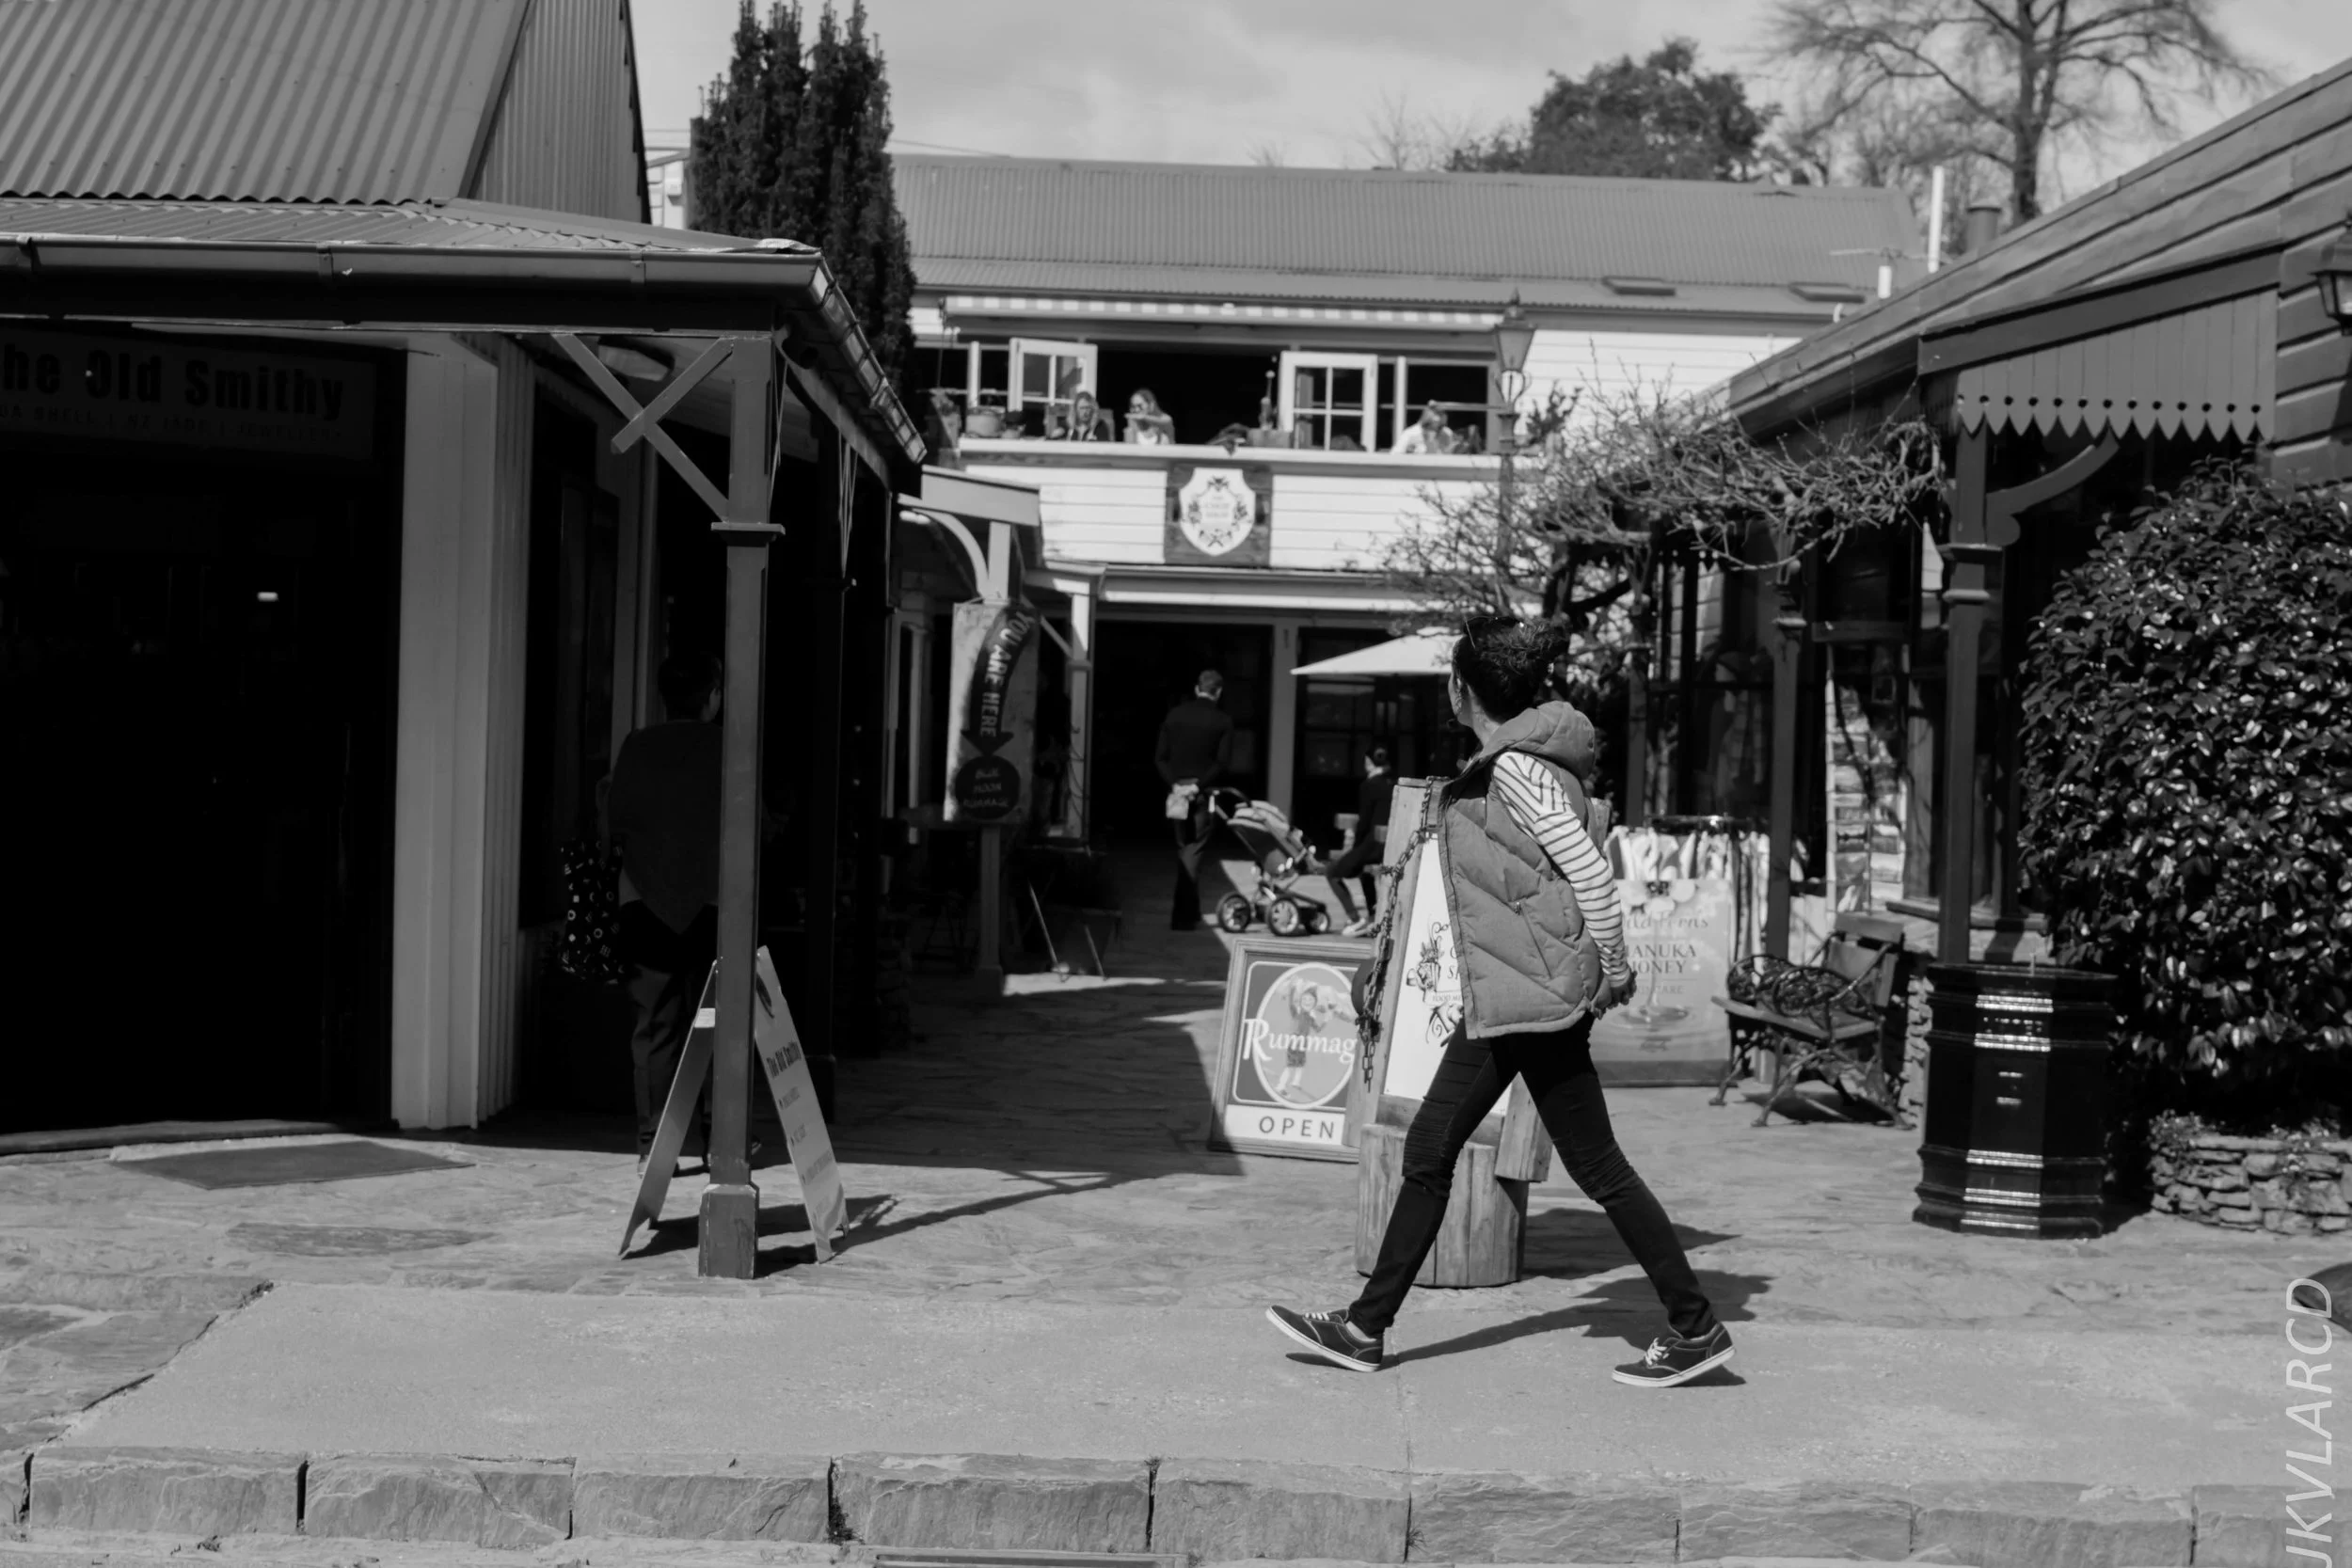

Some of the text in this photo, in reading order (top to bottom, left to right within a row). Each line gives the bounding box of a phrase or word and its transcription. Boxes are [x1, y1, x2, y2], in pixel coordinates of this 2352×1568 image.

[4, 342, 343, 421] he Old Smithy
[980, 611, 1036, 737] YOU ARE HERE
[1626, 911, 1652, 930] ild
[1626, 943, 1697, 958] ANUKA
[1242, 1018, 1357, 1065] Rummag
[1259, 1116, 1335, 1139] OPEN
